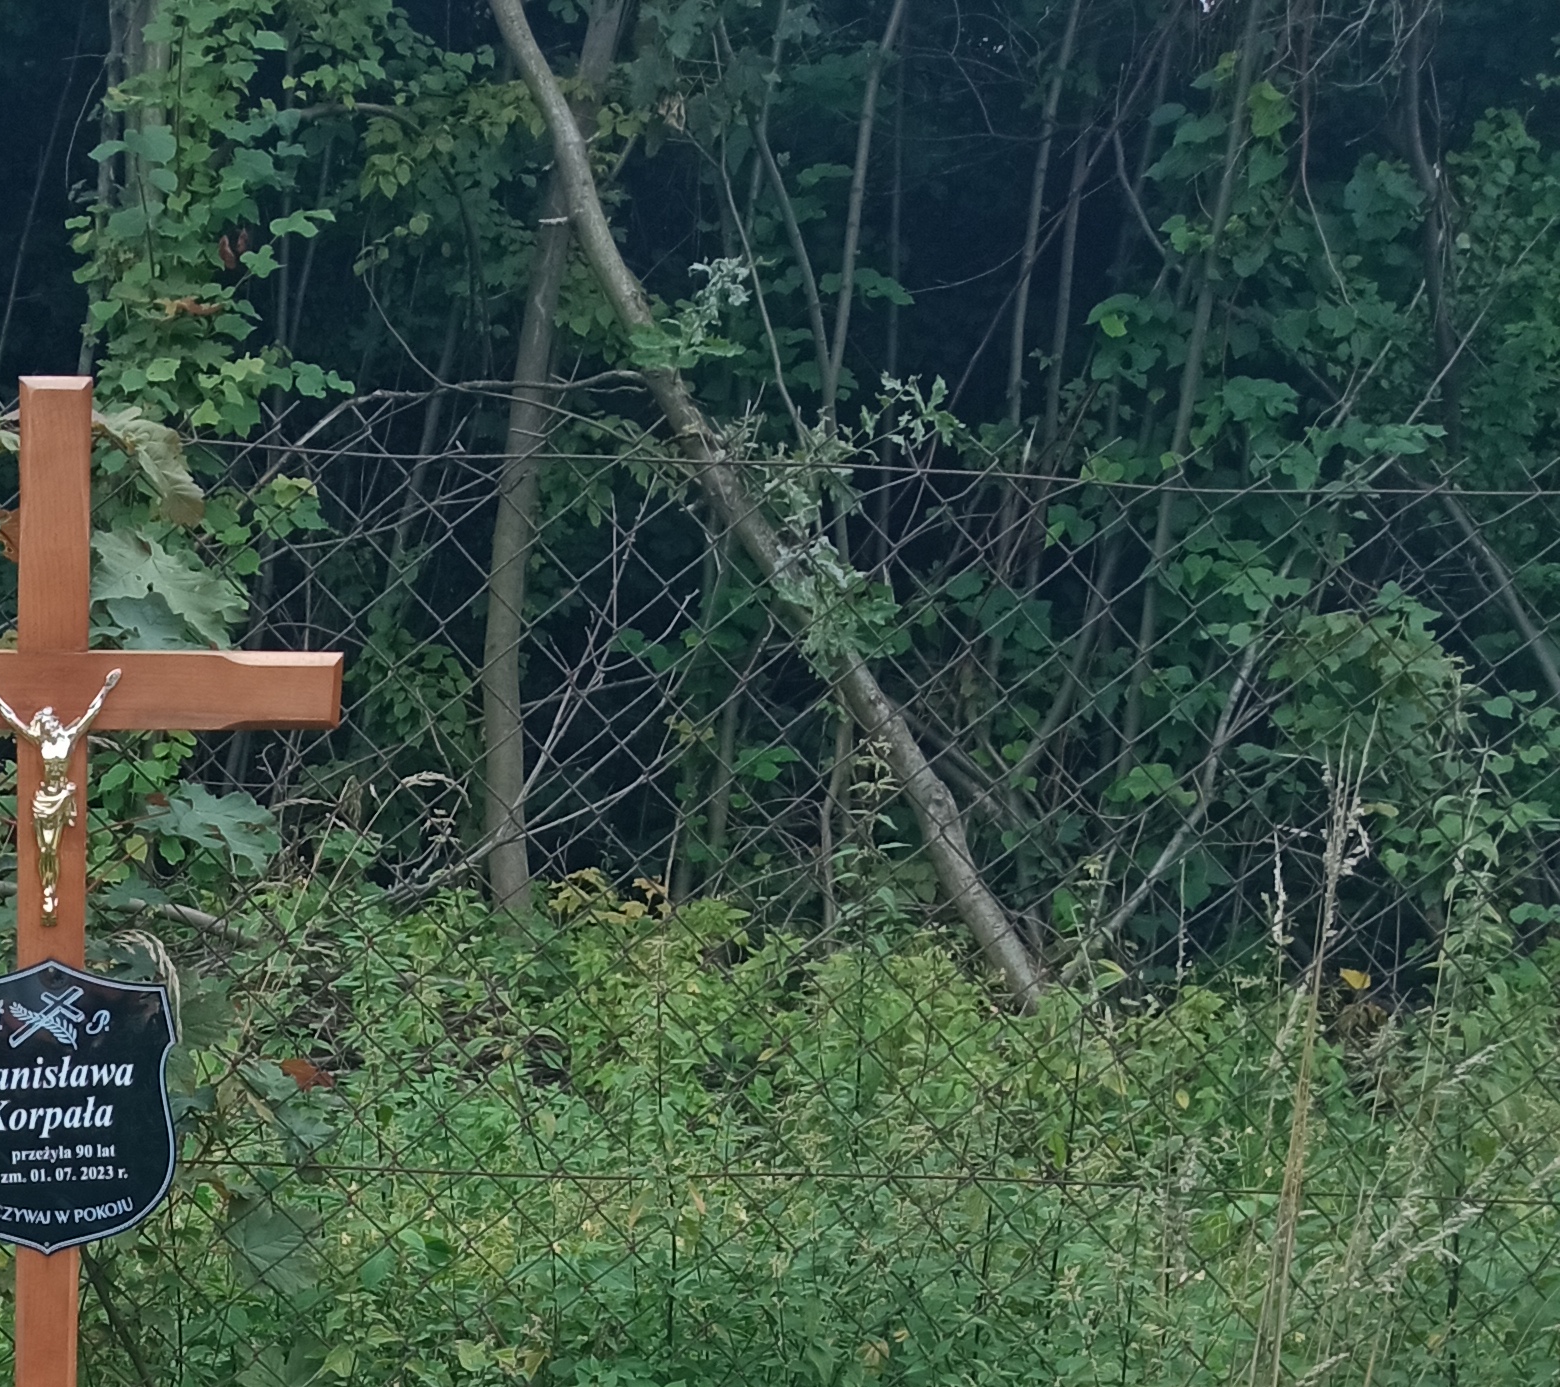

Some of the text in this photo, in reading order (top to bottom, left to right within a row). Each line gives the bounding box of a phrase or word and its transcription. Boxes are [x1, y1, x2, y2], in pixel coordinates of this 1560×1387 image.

[75, 1145, 93, 1159] 90
[96, 1144, 116, 1158] lat
[0, 1166, 129, 1184] zm. 01. 07. 2023 r.
[54, 1209, 71, 1224] W
[74, 1196, 134, 1223] POKOJU
